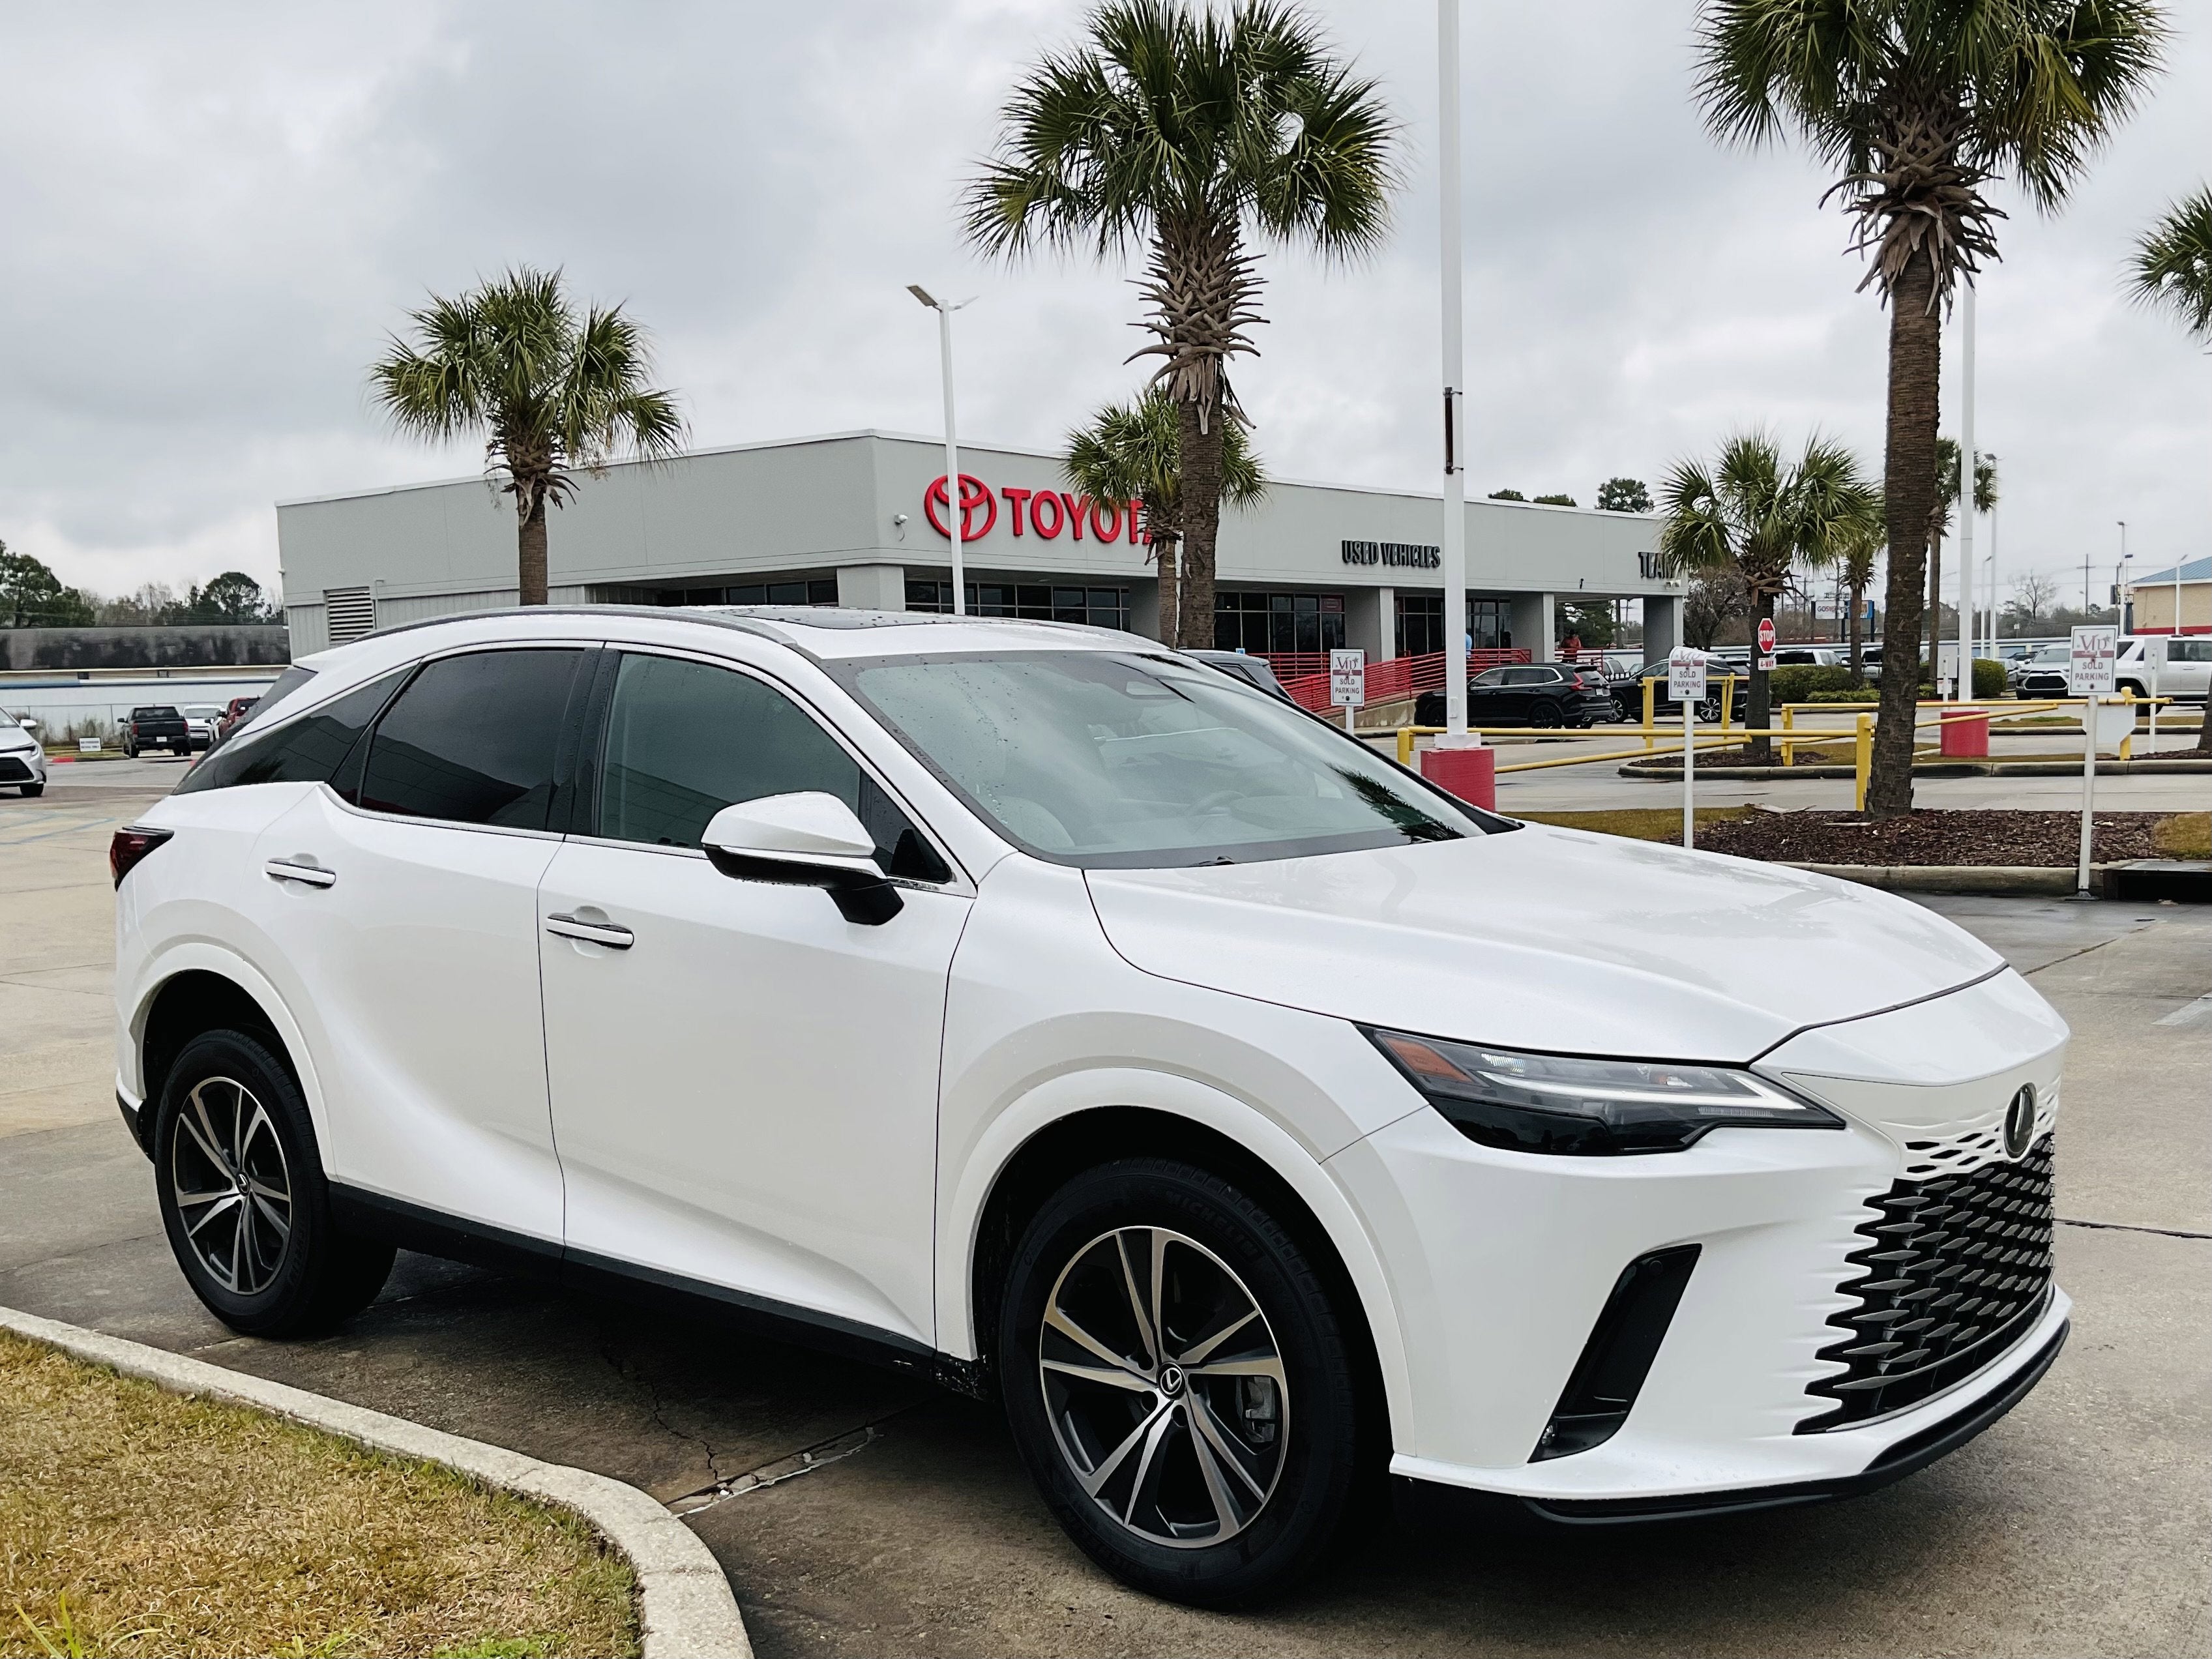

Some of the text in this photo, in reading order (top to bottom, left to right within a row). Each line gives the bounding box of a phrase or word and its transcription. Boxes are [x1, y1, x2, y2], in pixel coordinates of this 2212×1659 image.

[1001, 488, 1153, 545] TOYOT
[1342, 540, 1441, 568] USED VEHICLES
[1760, 630, 1774, 642] STOP
[2074, 672, 2110, 681] PARKING
